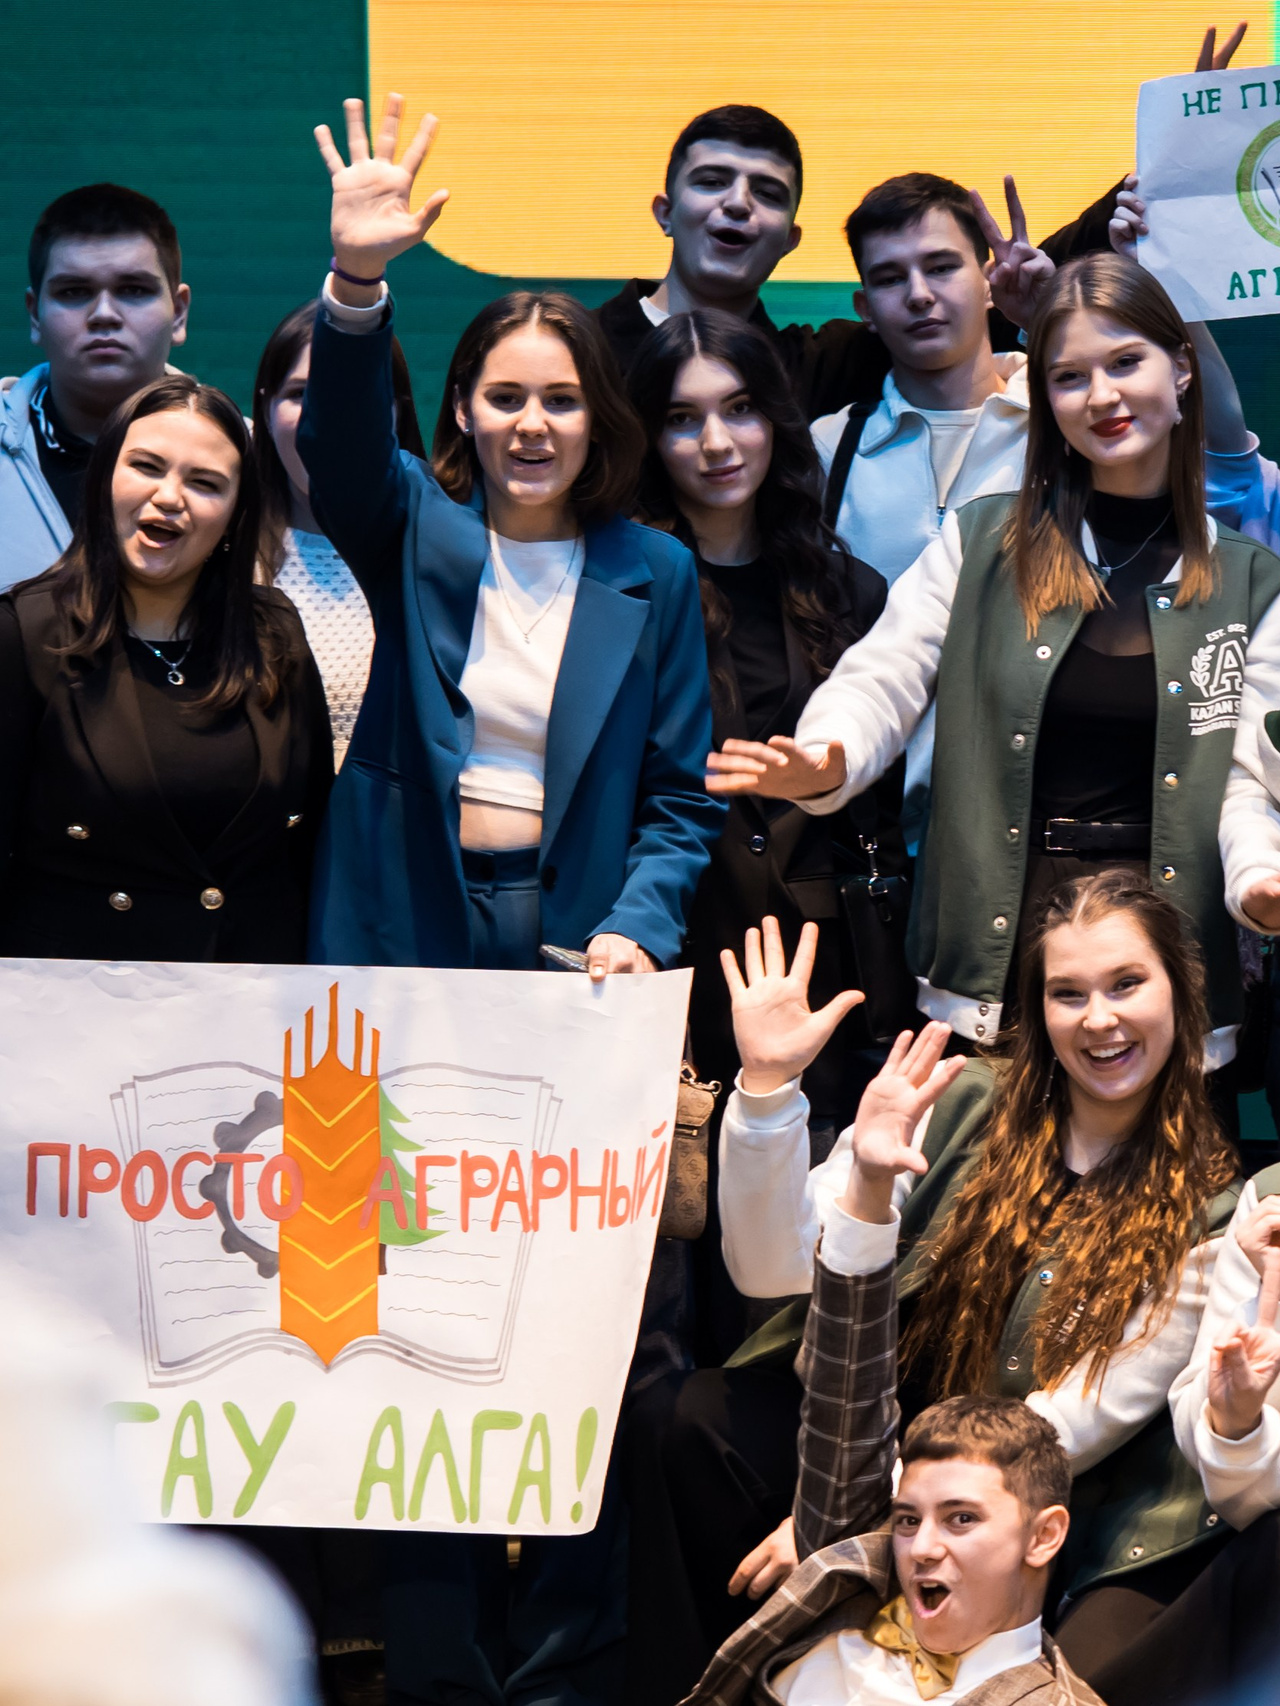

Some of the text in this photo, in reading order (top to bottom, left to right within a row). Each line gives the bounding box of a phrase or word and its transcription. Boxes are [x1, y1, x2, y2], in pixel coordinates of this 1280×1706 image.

[1182, 88, 1222, 117] НЕ
[1190, 700, 1233, 721] KAZAN
[26, 1120, 669, 1234] ПРОСТО АГРАРНЫЙ
[354, 1404, 598, 1525] АЛГА!
